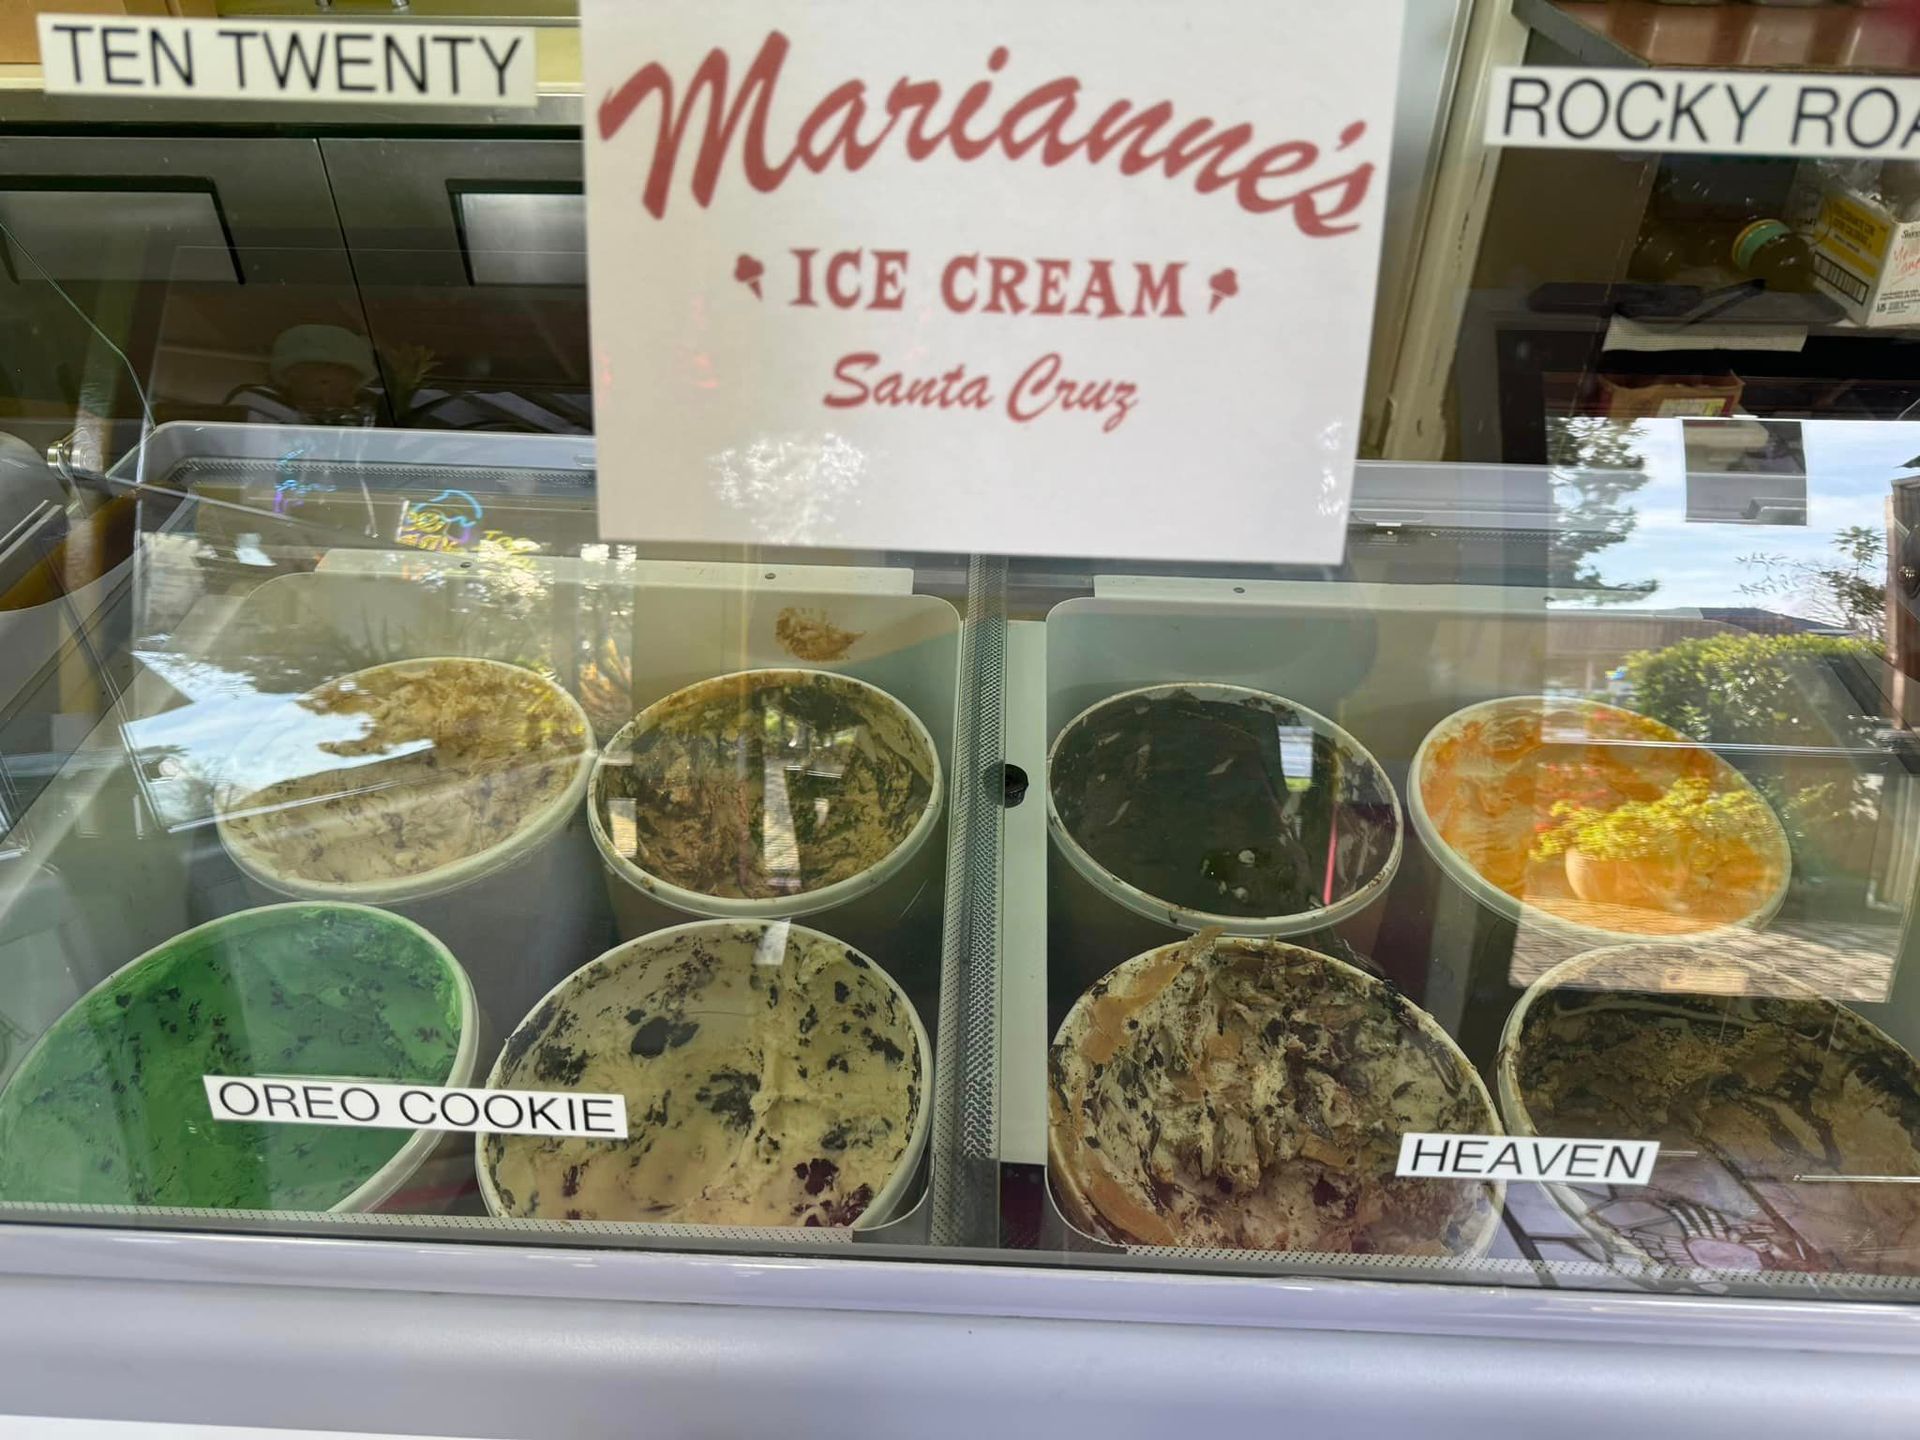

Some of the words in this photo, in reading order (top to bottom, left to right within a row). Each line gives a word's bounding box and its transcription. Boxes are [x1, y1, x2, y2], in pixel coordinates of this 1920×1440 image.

[53, 25, 194, 87] TEN
[218, 30, 522, 96] TWENTY
[597, 30, 1376, 238] Marianne's
[1503, 76, 1770, 143] ROCKY
[789, 248, 909, 310] ICE
[940, 255, 1187, 319] CREAM
[823, 353, 992, 410] Santa
[1006, 352, 1139, 432] Cruz
[219, 1081, 380, 1122] OREO
[399, 1090, 616, 1132] COOKIE
[1411, 1138, 1645, 1178] HEAVEN
